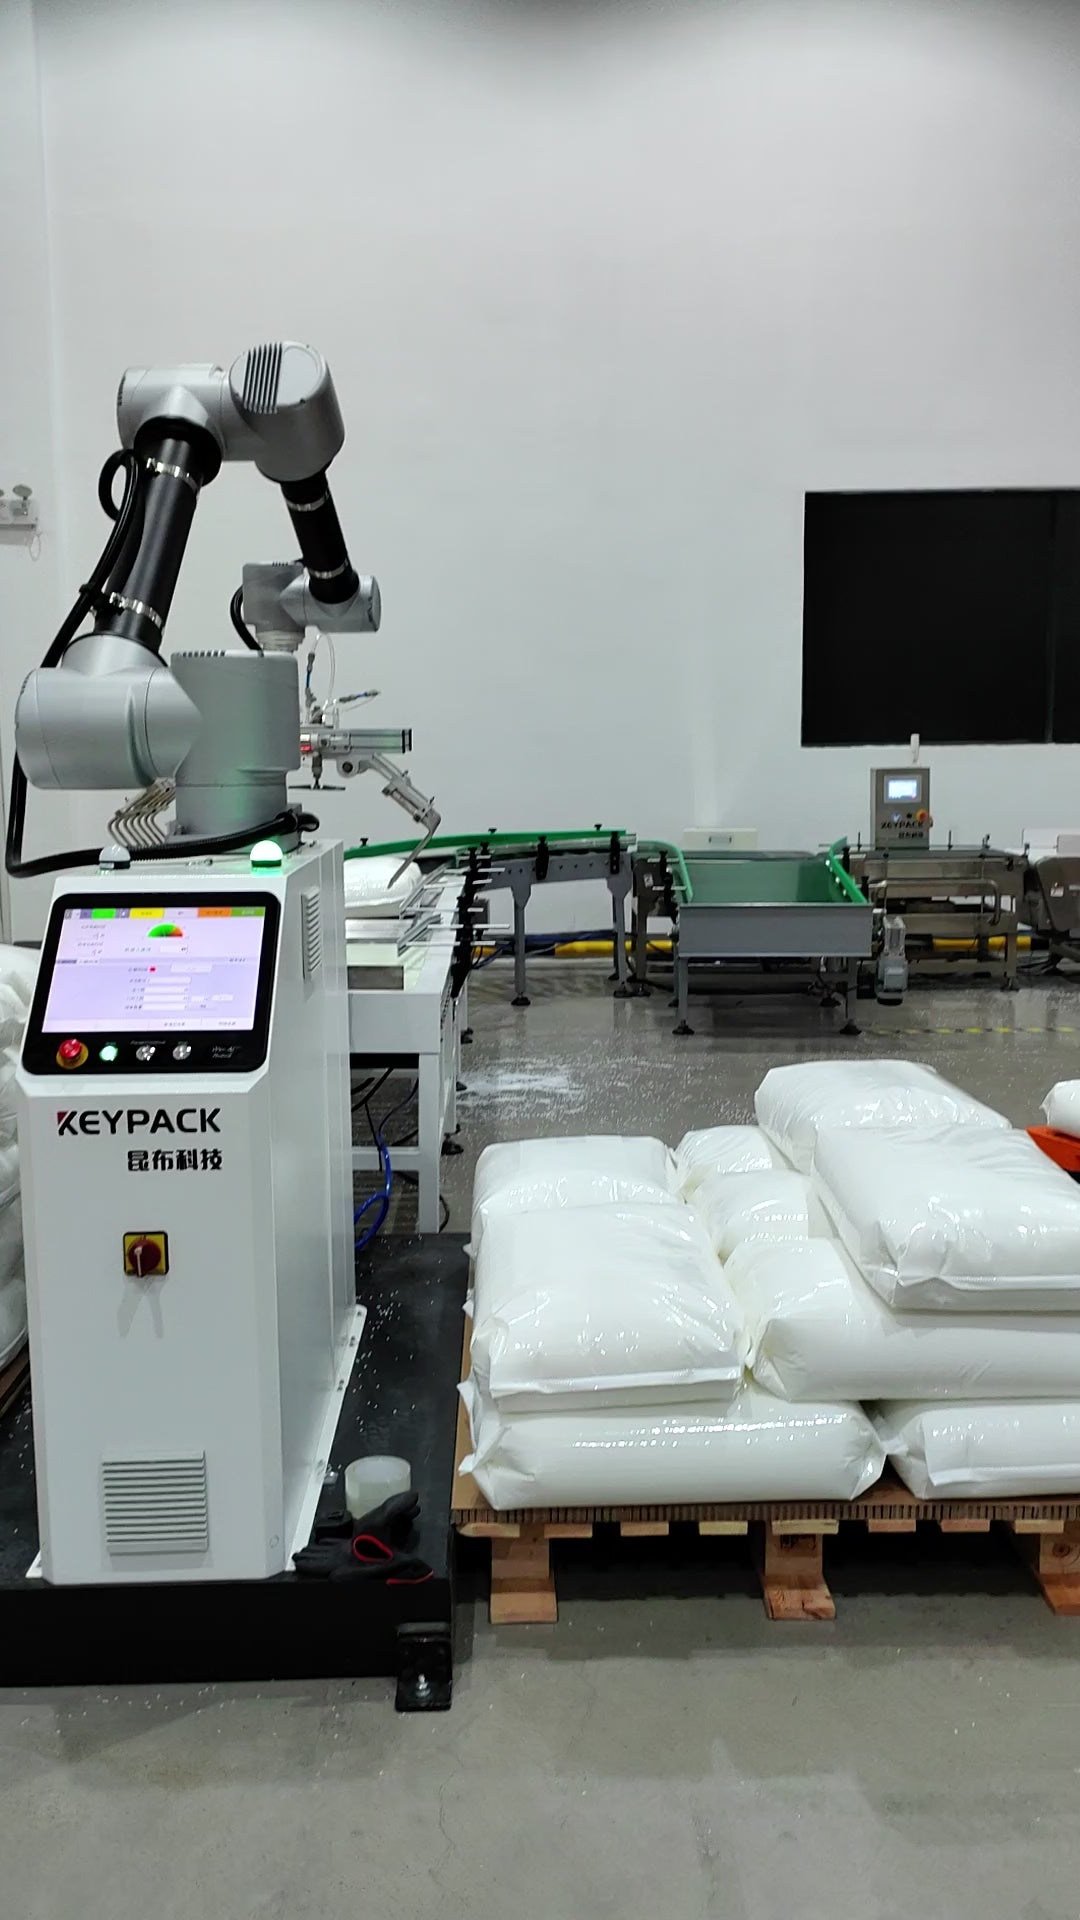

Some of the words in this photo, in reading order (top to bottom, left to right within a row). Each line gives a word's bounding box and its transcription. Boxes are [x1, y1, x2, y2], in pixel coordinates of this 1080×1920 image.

[57, 1108, 221, 1136] KEYPACK
[127, 1148, 223, 1171] 昆布科技
